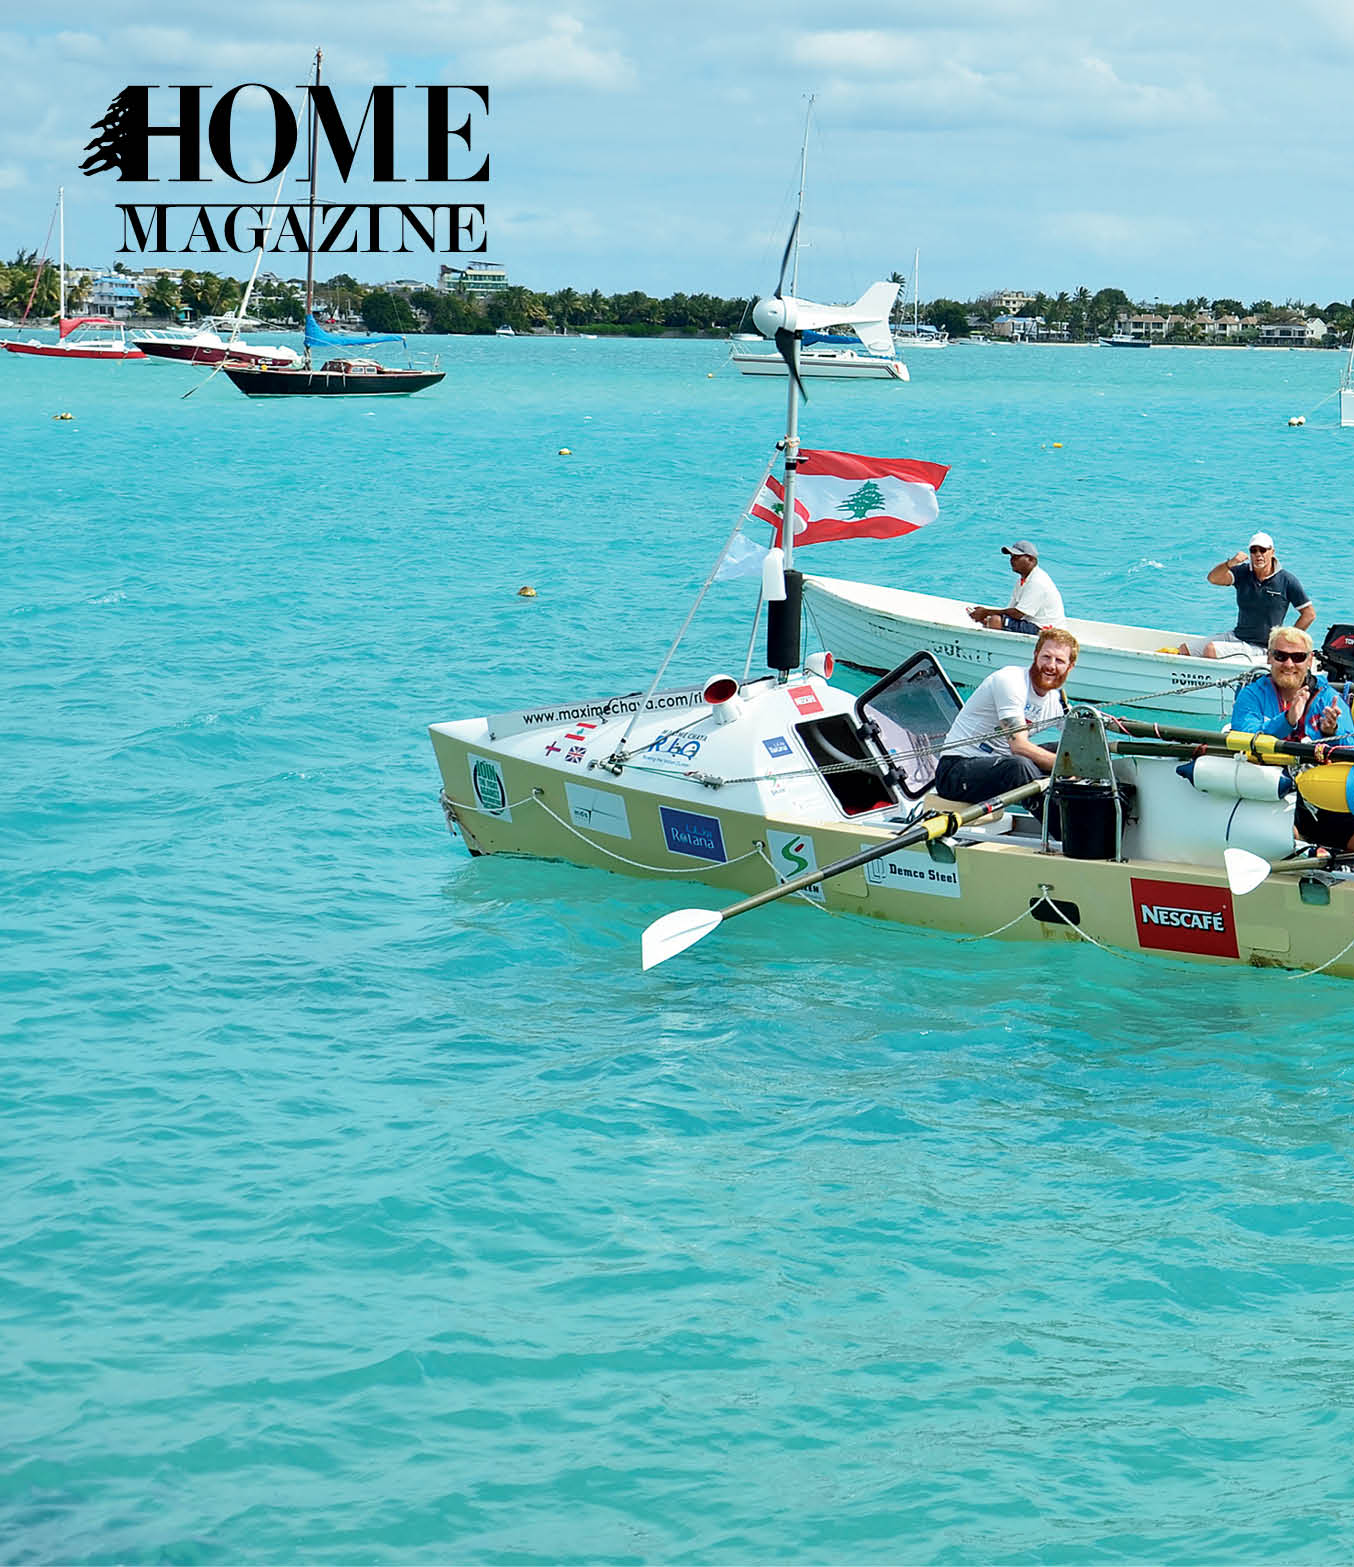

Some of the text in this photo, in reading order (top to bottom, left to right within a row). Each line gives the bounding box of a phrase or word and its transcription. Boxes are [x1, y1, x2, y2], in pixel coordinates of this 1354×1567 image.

[522, 690, 703, 725] www.maximechaa.com/ri
[671, 827, 715, 849] Rotana
[889, 863, 957, 884] Demco Steel
[1140, 903, 1225, 931] NESCAFÉ
